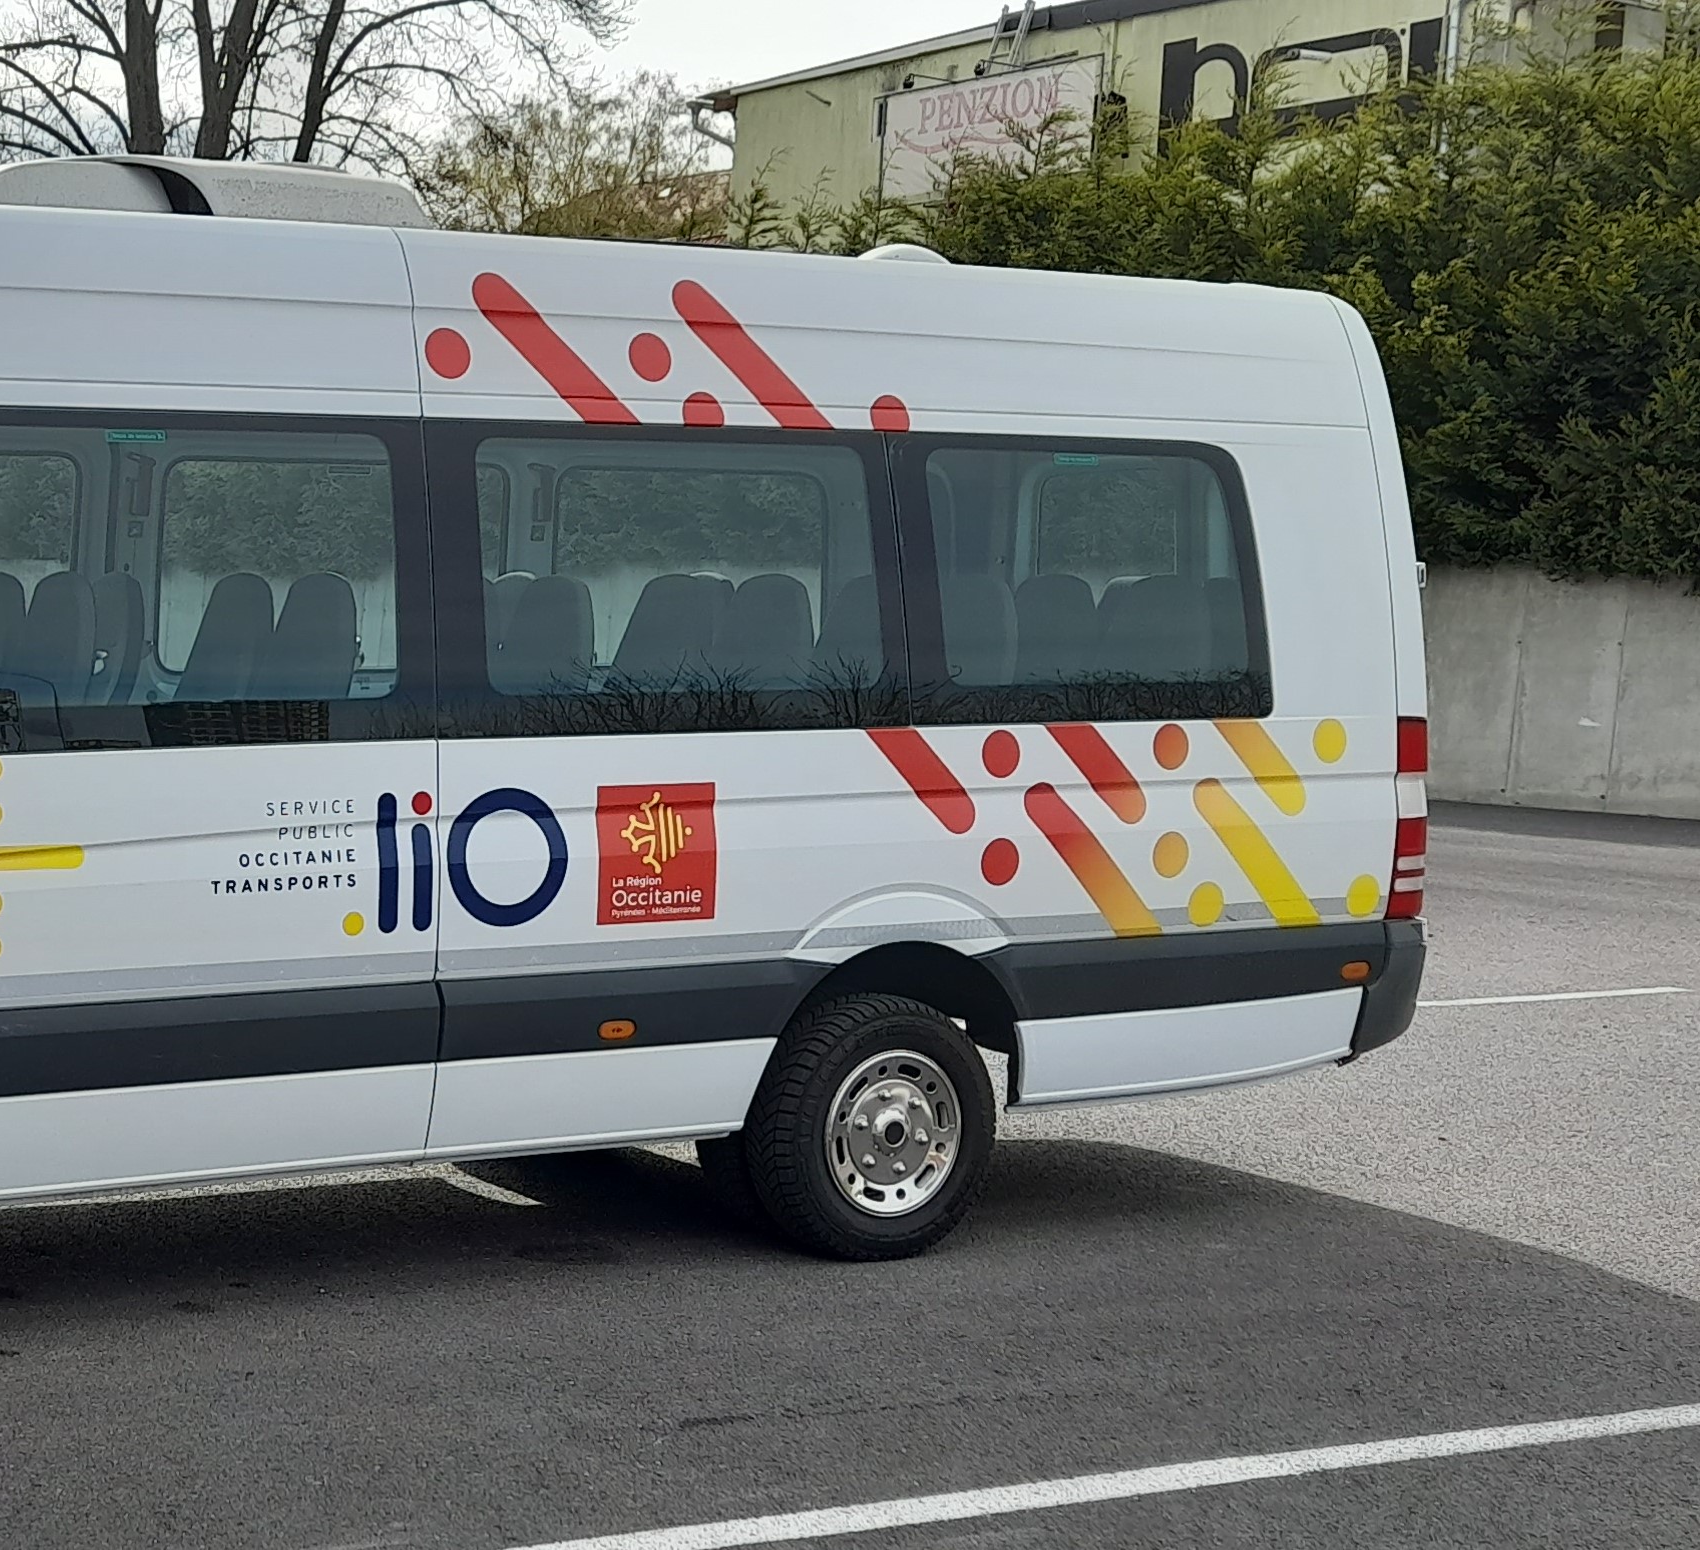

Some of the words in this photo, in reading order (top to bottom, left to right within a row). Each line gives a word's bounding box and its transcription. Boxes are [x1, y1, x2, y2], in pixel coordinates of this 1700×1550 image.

[918, 72, 1062, 135] PENZION
[266, 800, 354, 816] SERVICE
[278, 824, 354, 840] PUBLIC
[239, 849, 356, 867] OCCITANIE
[211, 874, 356, 894] TRANSPORTS
[612, 877, 624, 887] La
[626, 875, 662, 888] Région
[612, 886, 702, 907] Occitanie
